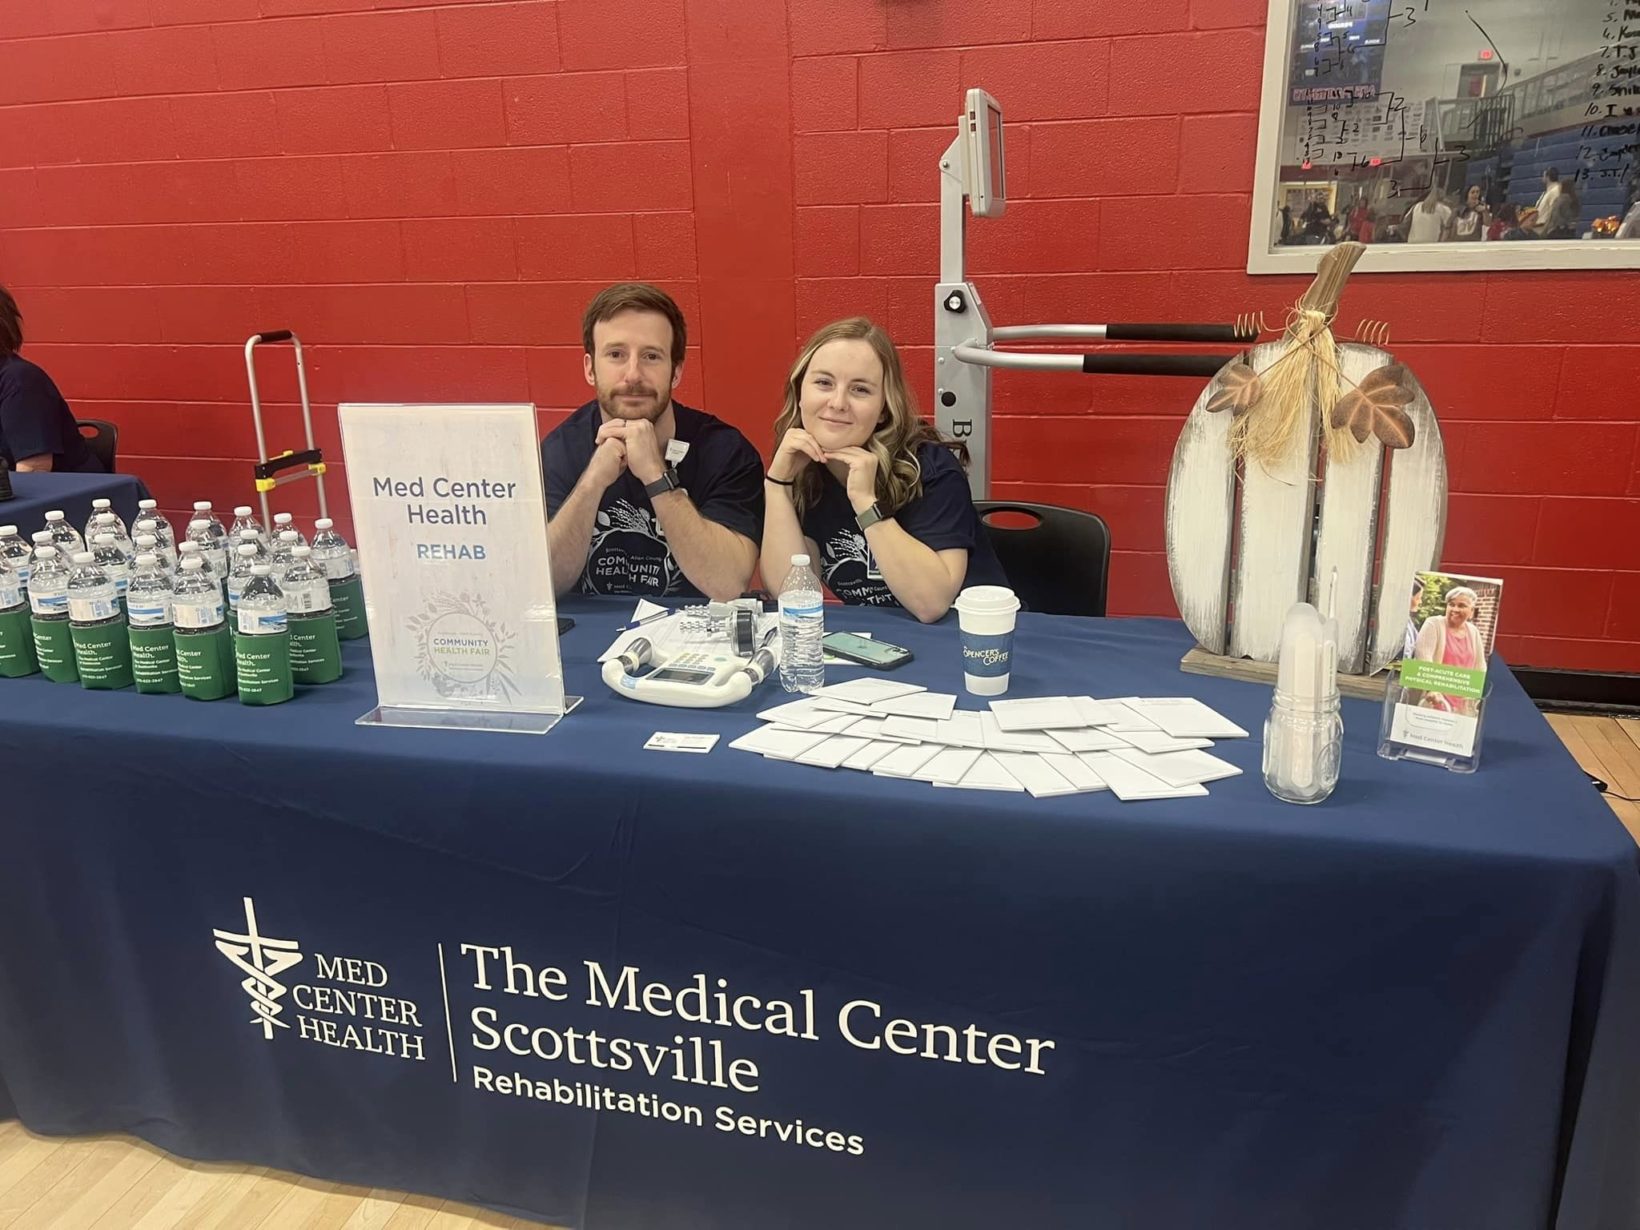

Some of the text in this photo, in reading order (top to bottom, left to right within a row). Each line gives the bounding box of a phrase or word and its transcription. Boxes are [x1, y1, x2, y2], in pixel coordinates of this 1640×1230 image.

[373, 477, 516, 499] Med Center
[407, 504, 487, 525] Health
[416, 543, 486, 560] REHAB
[433, 638, 489, 647] COMMUNITY
[434, 646, 490, 656] HEALTH FAIR
[314, 953, 388, 988] MED
[292, 984, 422, 1027] CENTER
[460, 943, 1056, 1075] The Medical Center
[297, 1014, 426, 1061] HEALTH
[471, 1006, 760, 1093] Scottsville
[473, 1066, 865, 1156] Rehabilitation Services
